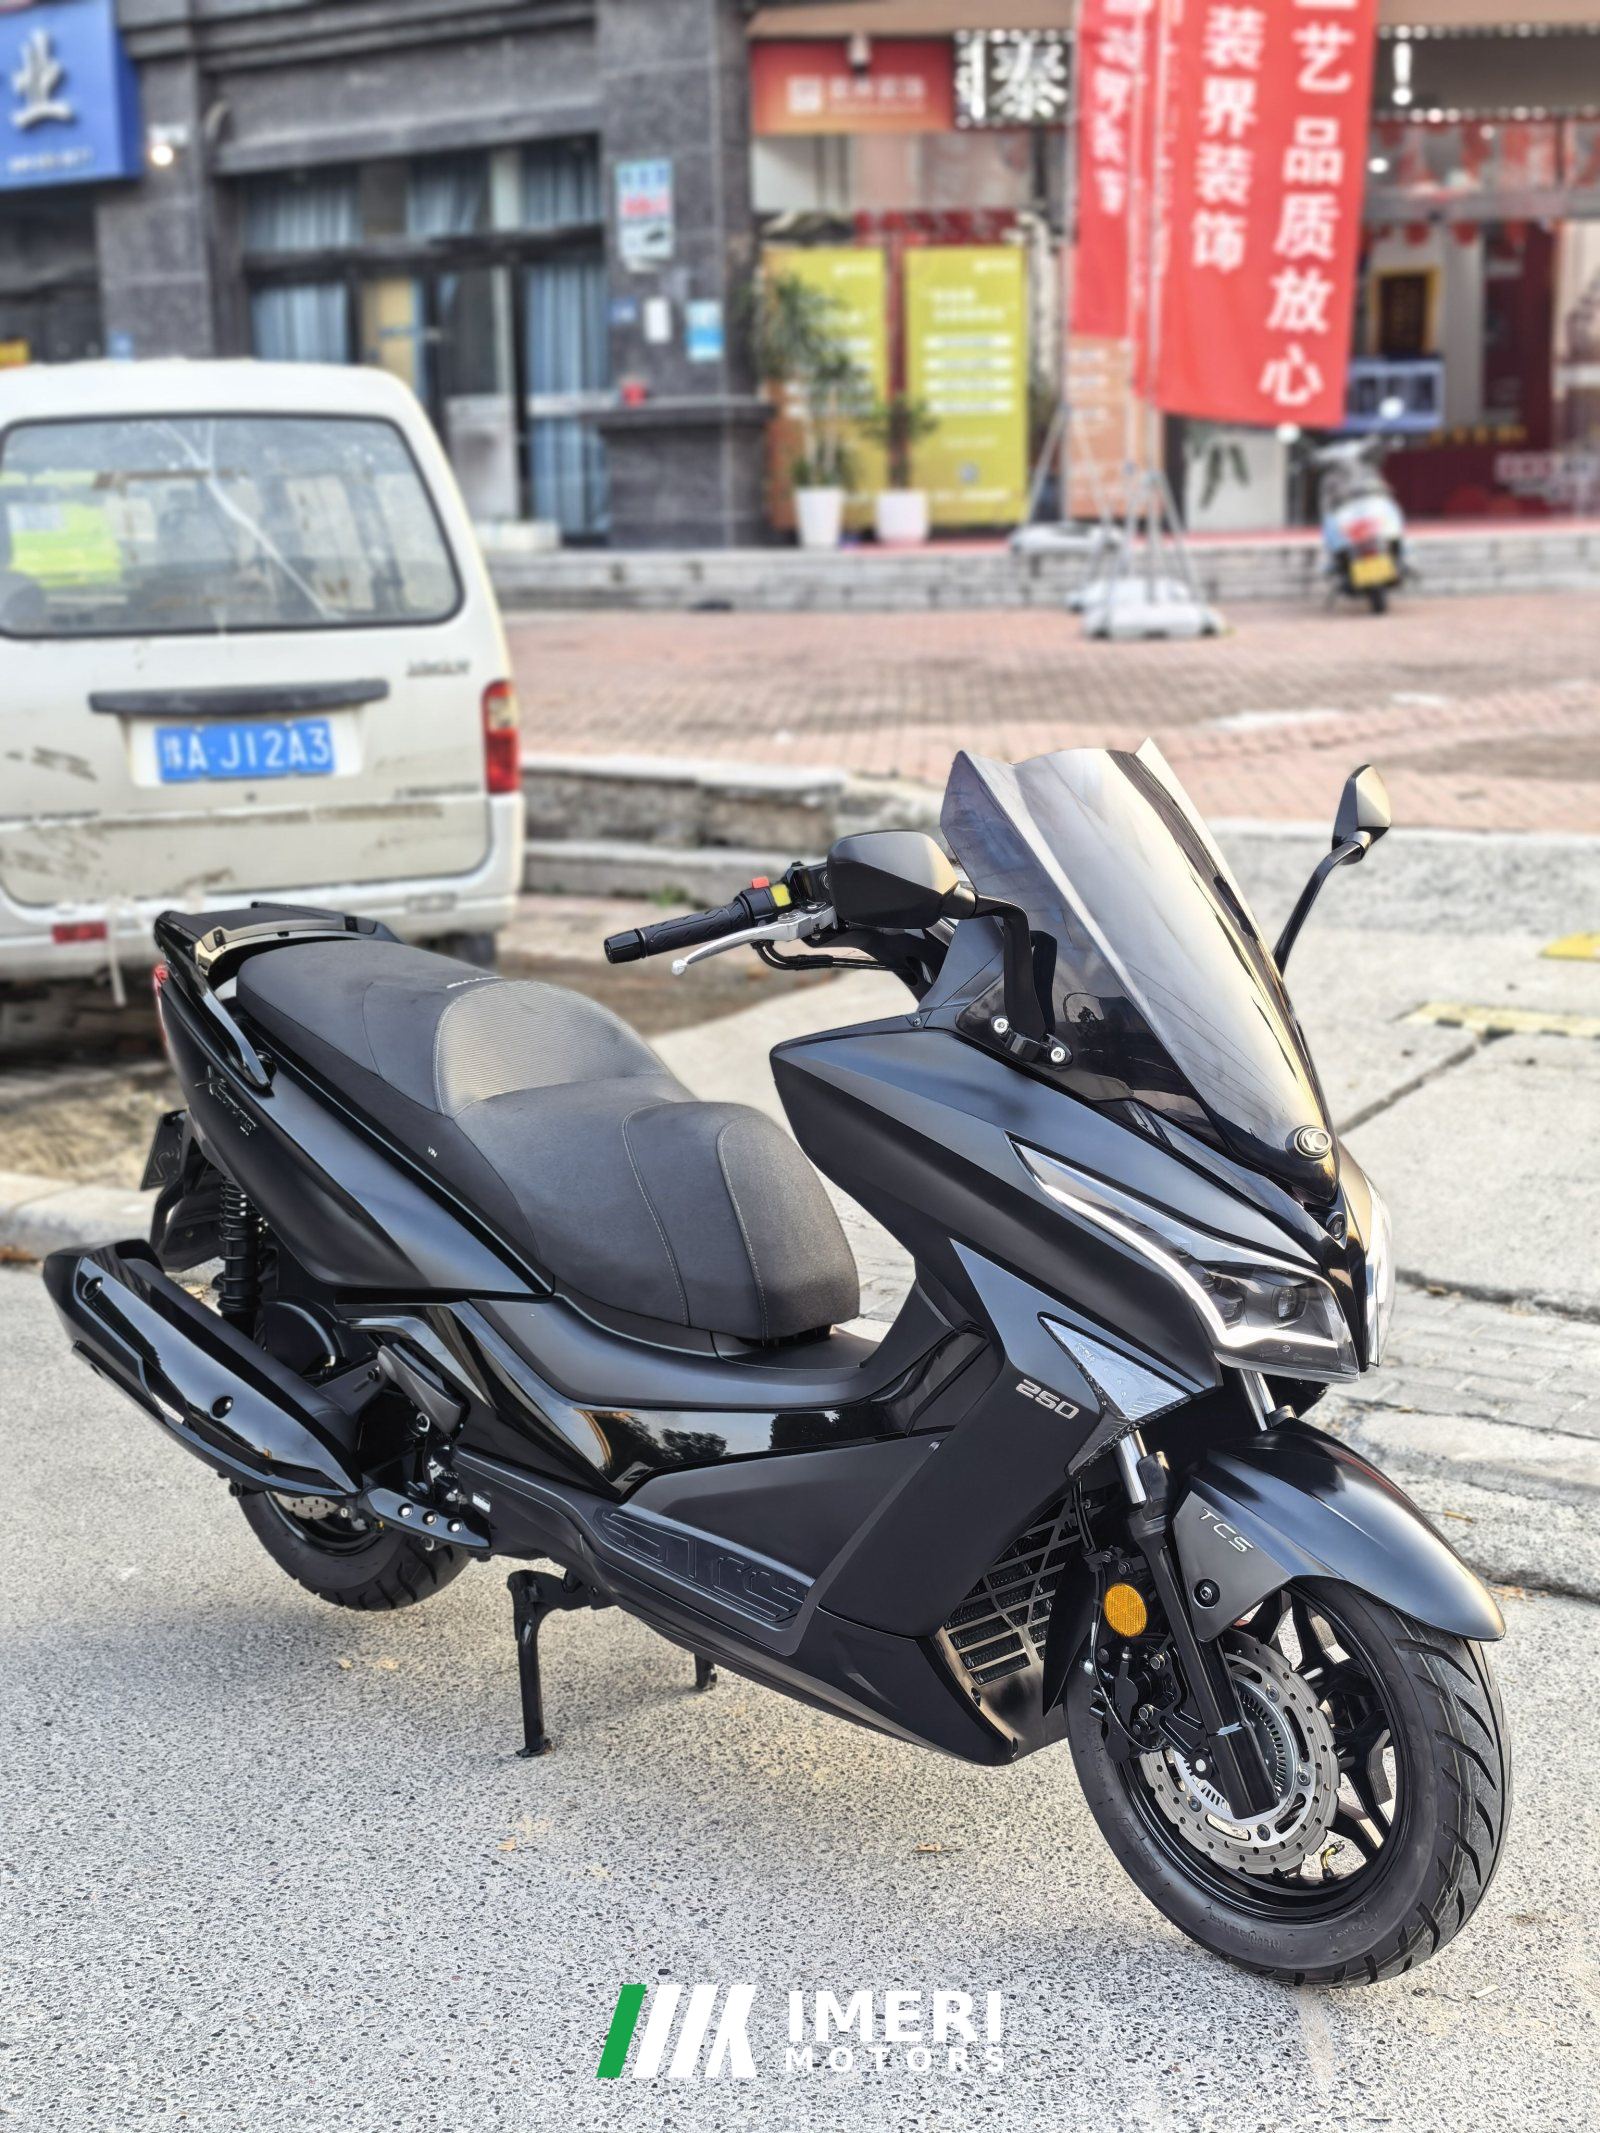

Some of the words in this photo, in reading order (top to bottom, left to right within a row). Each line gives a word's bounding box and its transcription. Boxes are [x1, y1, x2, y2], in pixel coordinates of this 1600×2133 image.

[1261, 0, 1355, 406] 艺品质放心
[1015, 1378, 1080, 1420] 250
[1200, 1507, 1254, 1553] TCS
